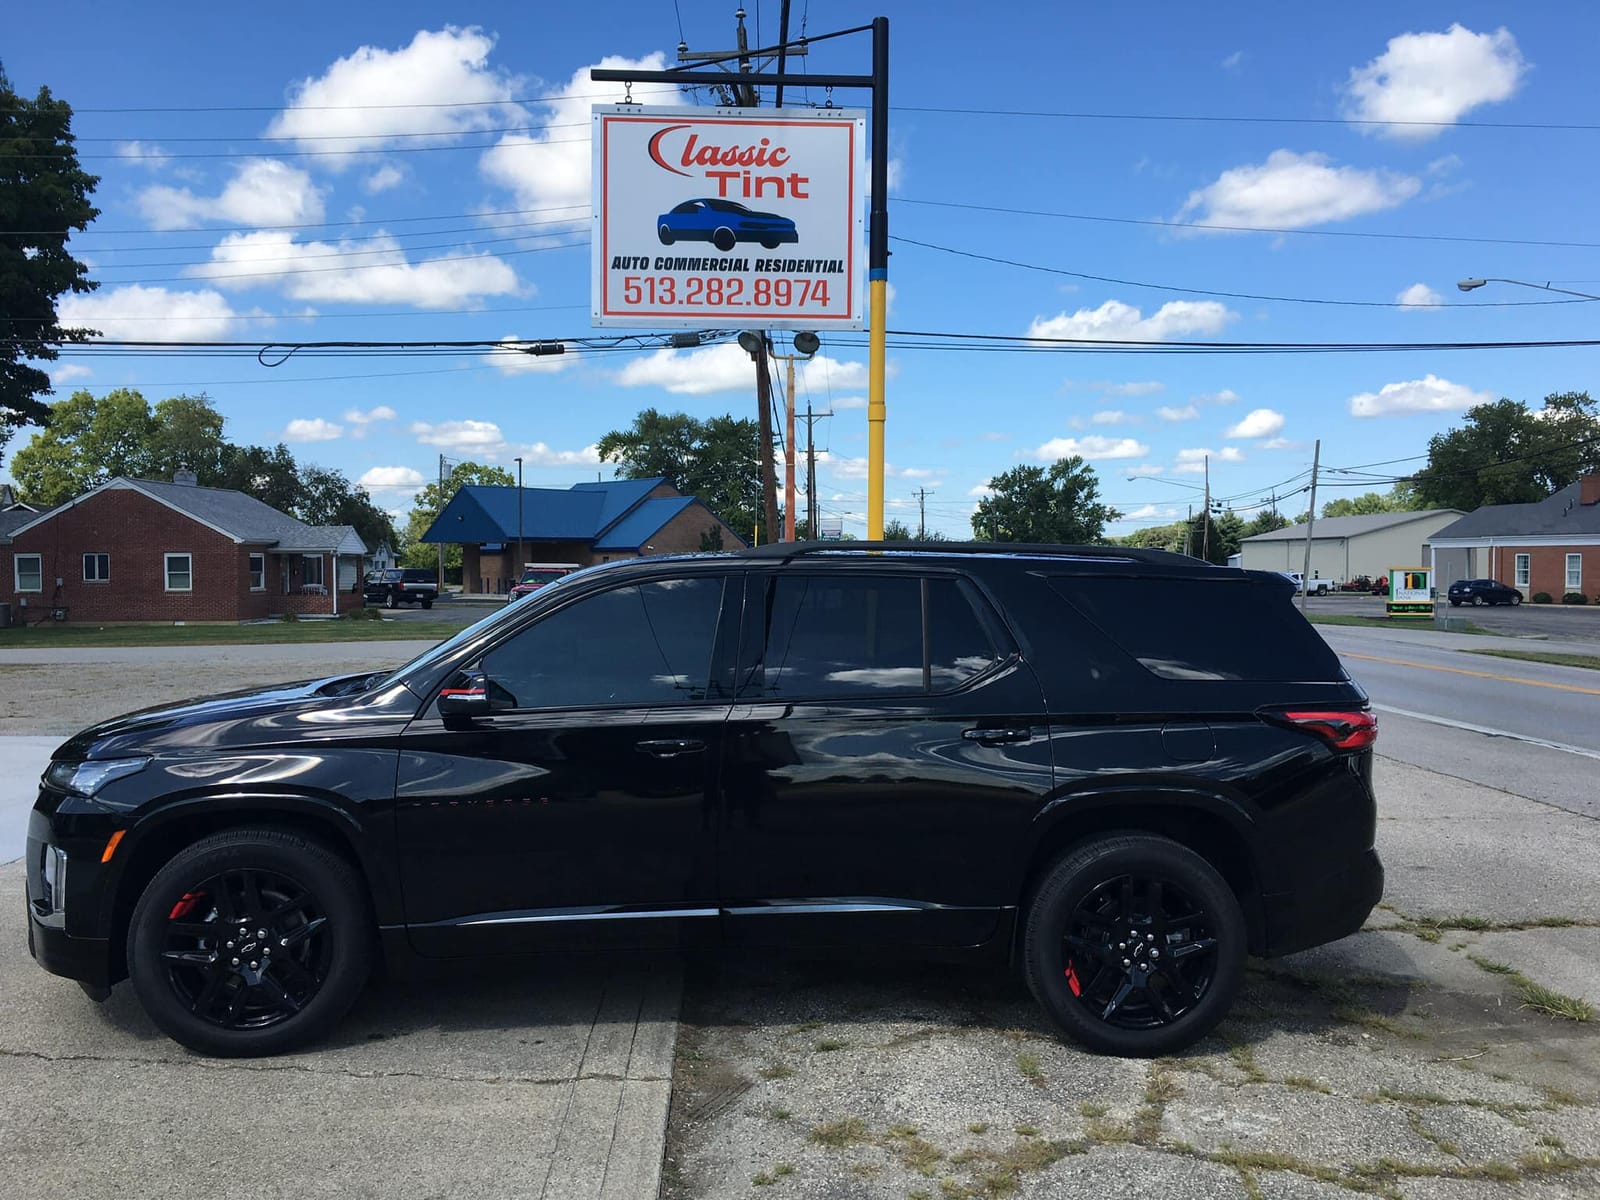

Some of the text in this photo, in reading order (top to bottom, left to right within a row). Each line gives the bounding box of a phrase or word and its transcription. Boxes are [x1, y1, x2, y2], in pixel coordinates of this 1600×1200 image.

[648, 124, 791, 177] Classic
[705, 170, 809, 199] Tint
[611, 256, 844, 274] AUTO COMMERCIAL RESIDENTIAL
[624, 276, 830, 307] 513.282.8974
